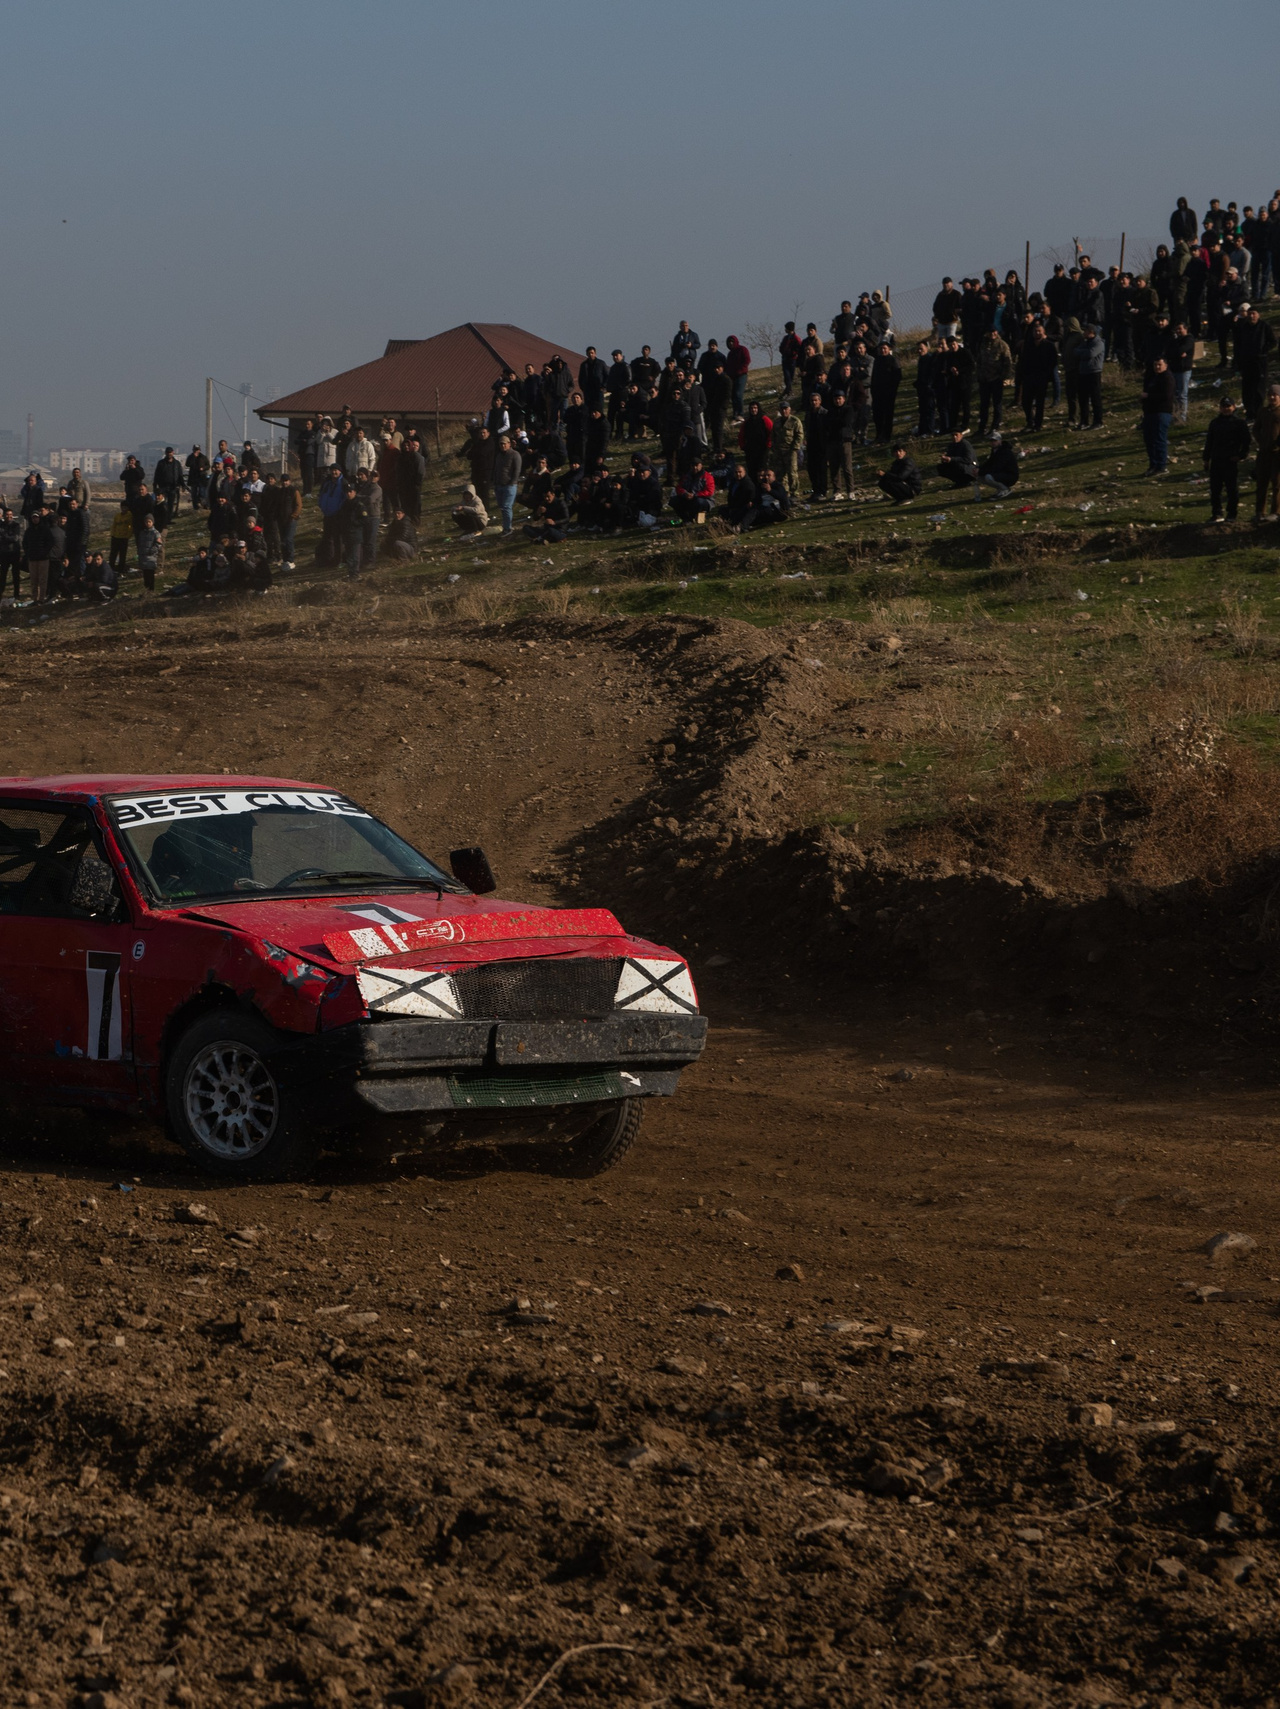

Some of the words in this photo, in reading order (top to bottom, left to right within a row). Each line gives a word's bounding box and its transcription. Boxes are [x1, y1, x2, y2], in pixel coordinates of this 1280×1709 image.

[114, 794, 229, 824] BEST
[134, 944, 143, 957] E
[88, 952, 121, 1060] 7
